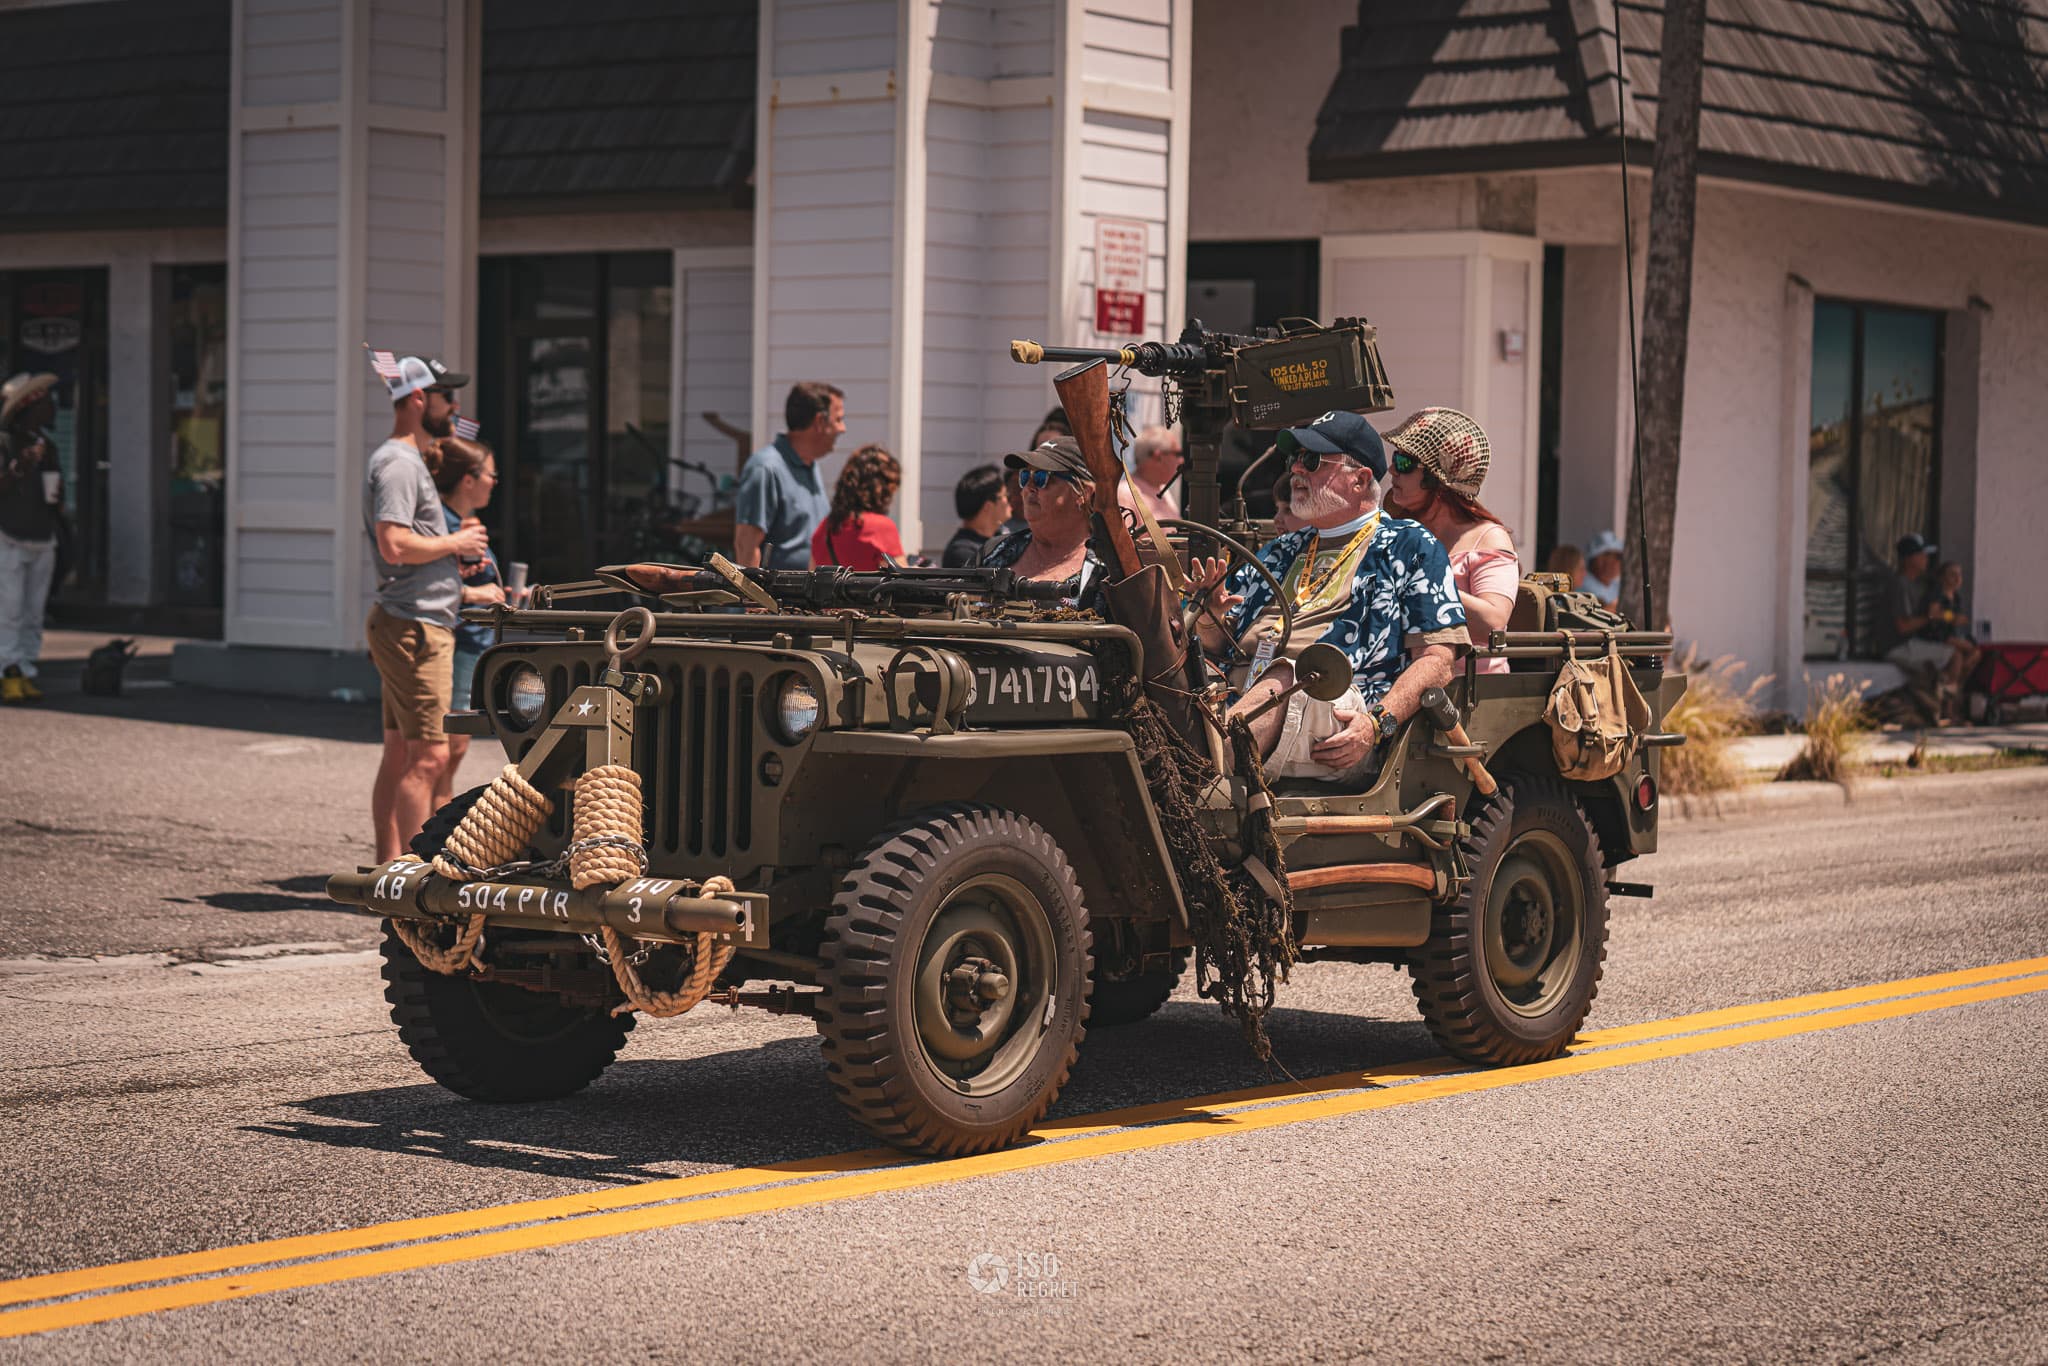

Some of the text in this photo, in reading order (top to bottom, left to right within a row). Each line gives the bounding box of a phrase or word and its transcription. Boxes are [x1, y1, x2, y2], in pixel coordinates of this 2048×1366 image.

[373, 874, 407, 900] AB
[457, 884, 510, 911] 504
[626, 880, 673, 895] HQ
[627, 897, 643, 924] 3
